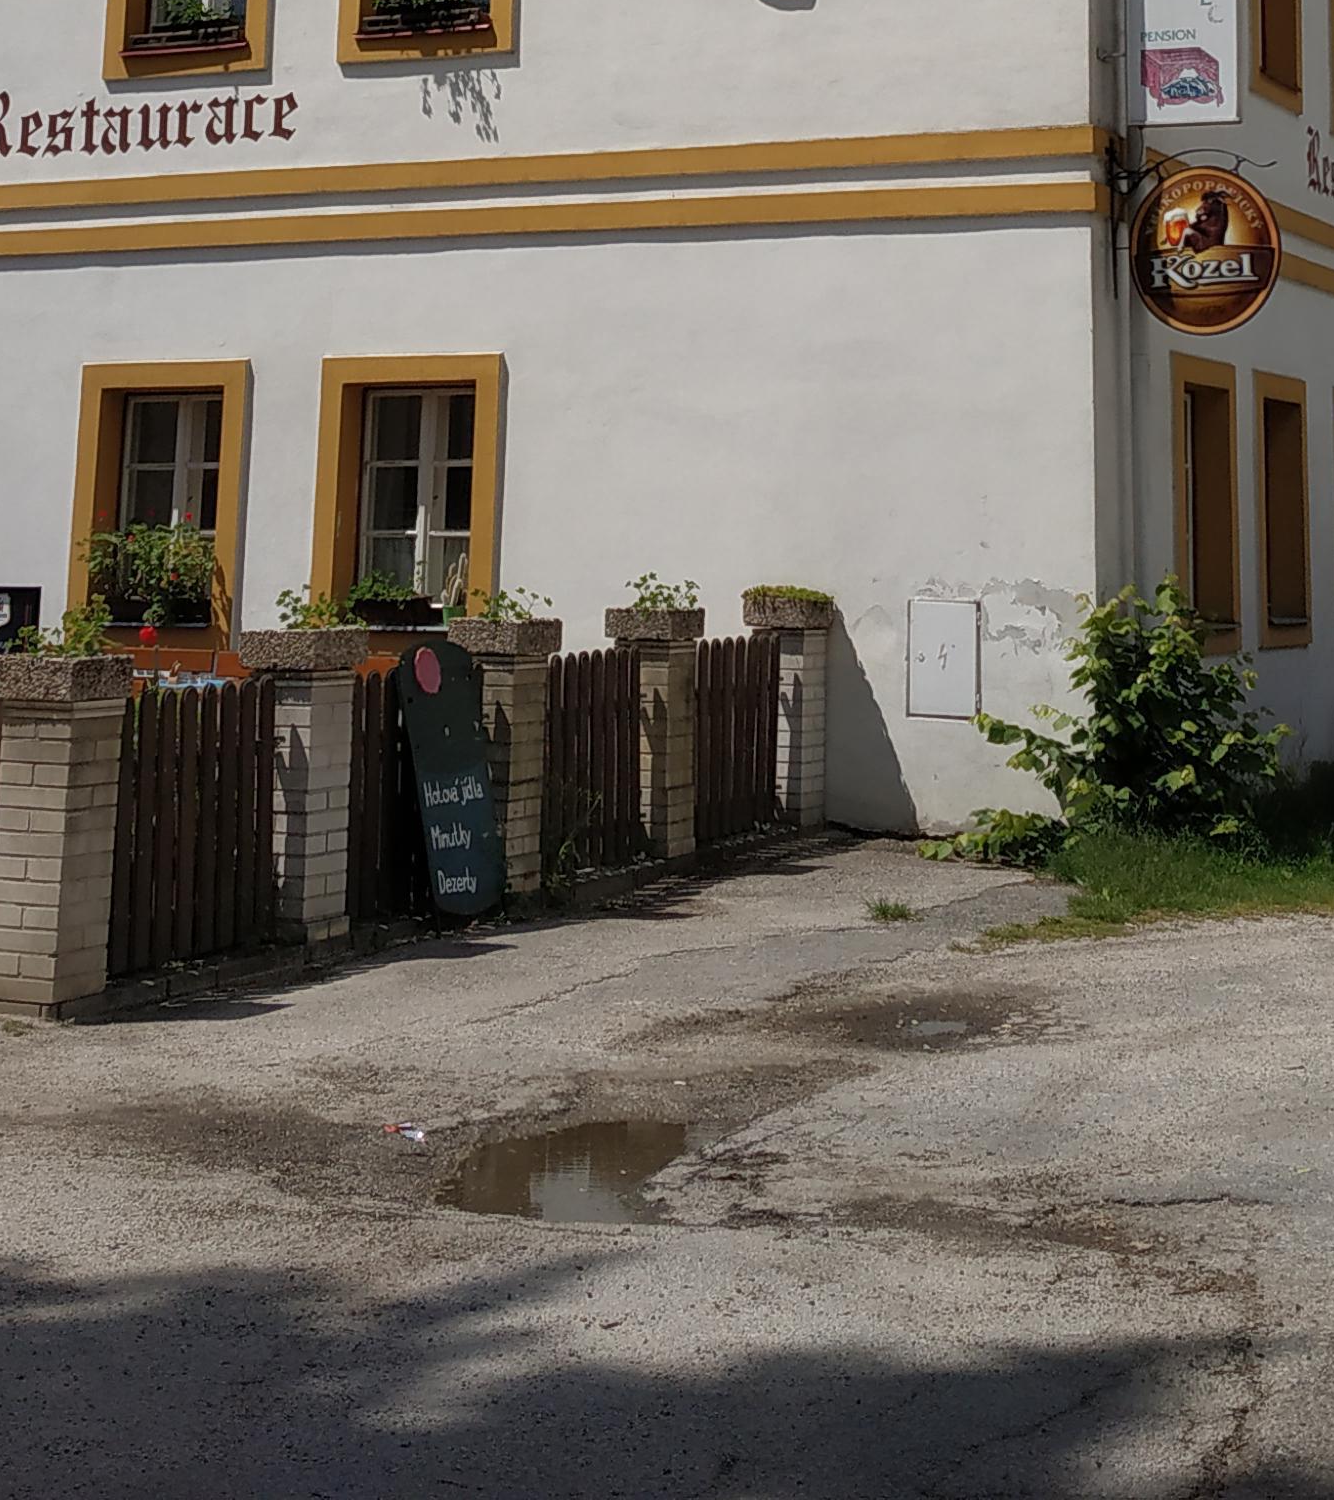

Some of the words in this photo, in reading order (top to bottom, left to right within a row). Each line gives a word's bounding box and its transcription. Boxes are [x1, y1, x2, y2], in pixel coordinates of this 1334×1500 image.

[1141, 28, 1196, 43] PENSION
[1150, 253, 1259, 288] Kozel
[424, 778, 460, 808] Hotová
[461, 775, 484, 807] jídla
[430, 822, 471, 850] Minutky
[437, 866, 477, 895] Dezerty
